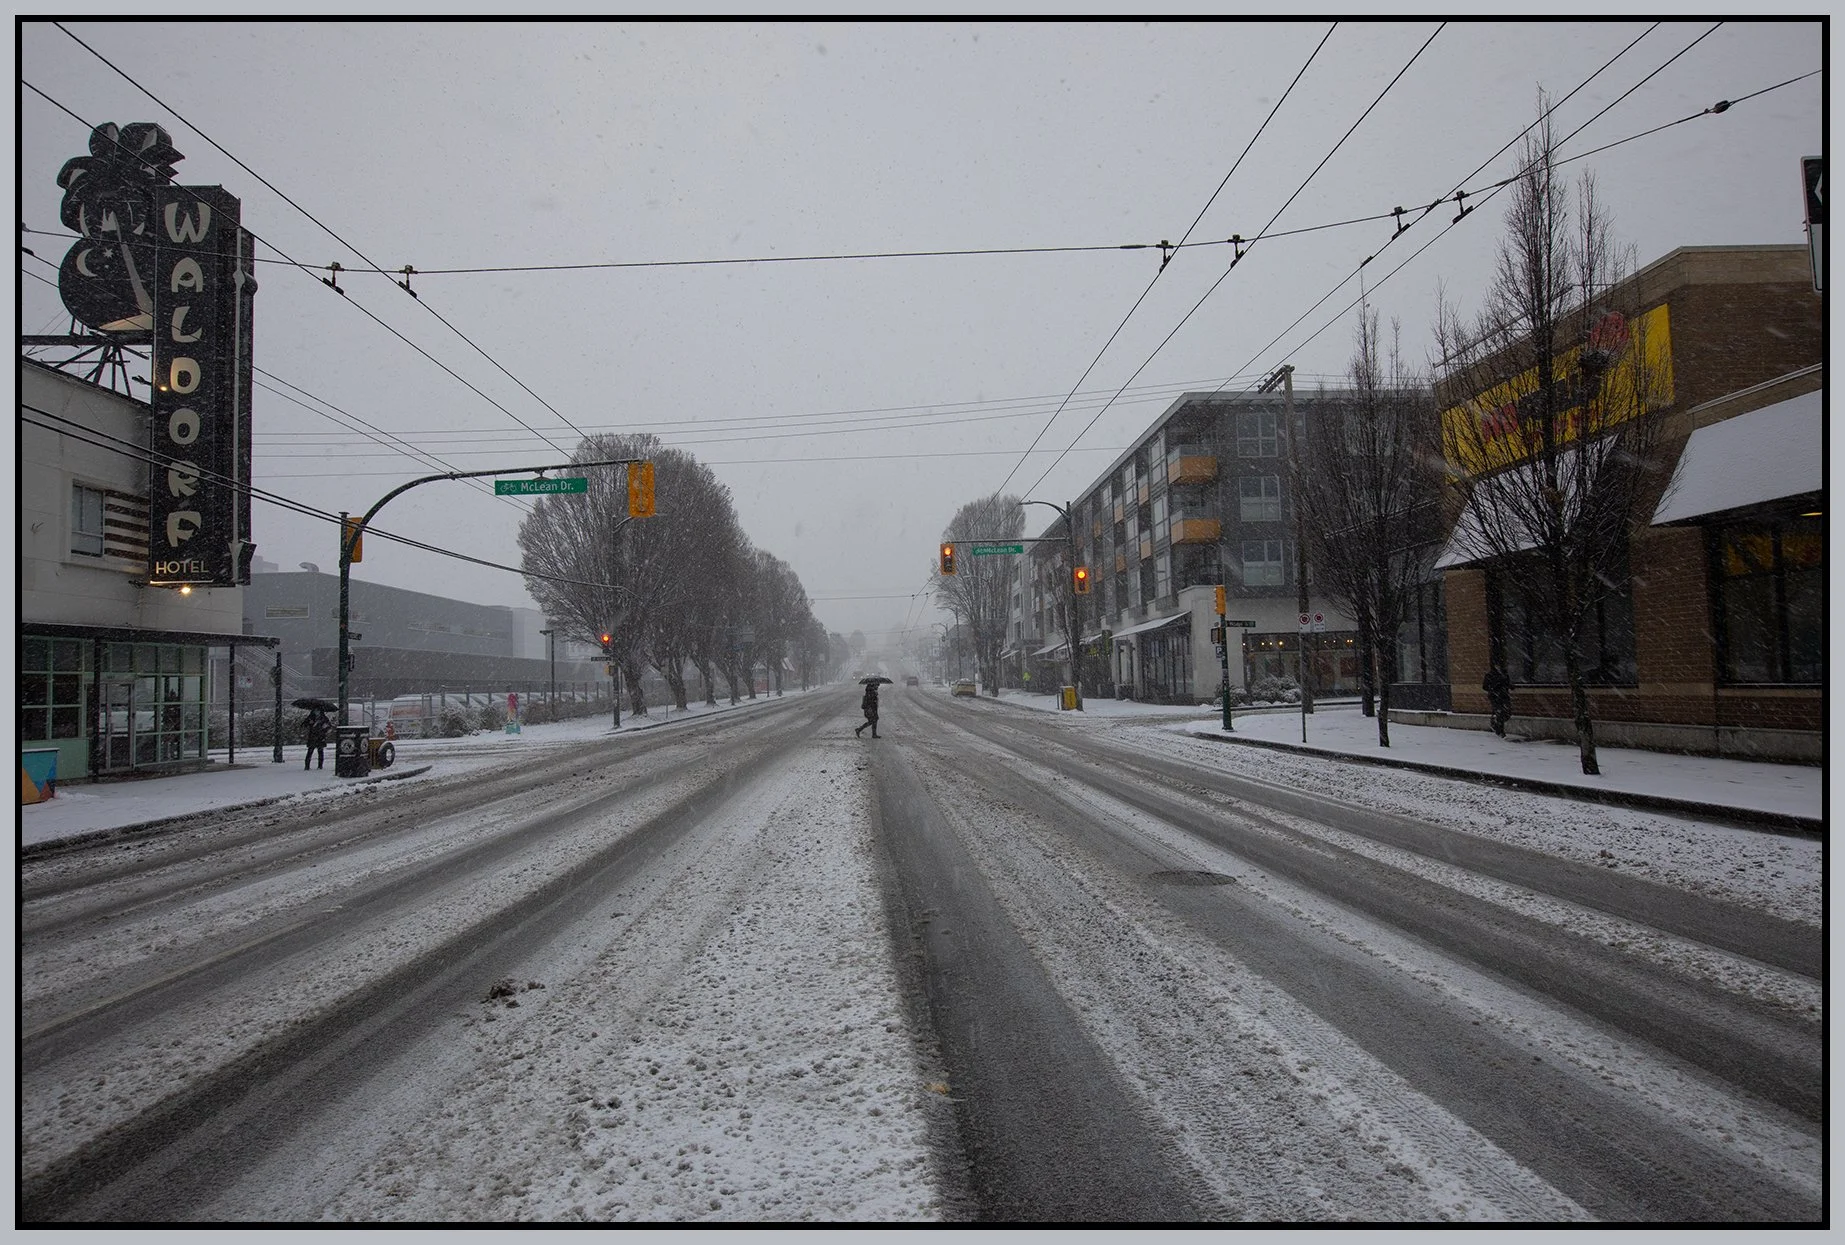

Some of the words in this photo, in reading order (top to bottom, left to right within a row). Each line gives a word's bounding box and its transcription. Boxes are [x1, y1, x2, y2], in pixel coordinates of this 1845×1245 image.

[164, 202, 211, 547] WALDORF
[521, 481, 558, 492] McLean
[561, 480, 574, 490] Dr.
[155, 558, 209, 574] HOTEL
